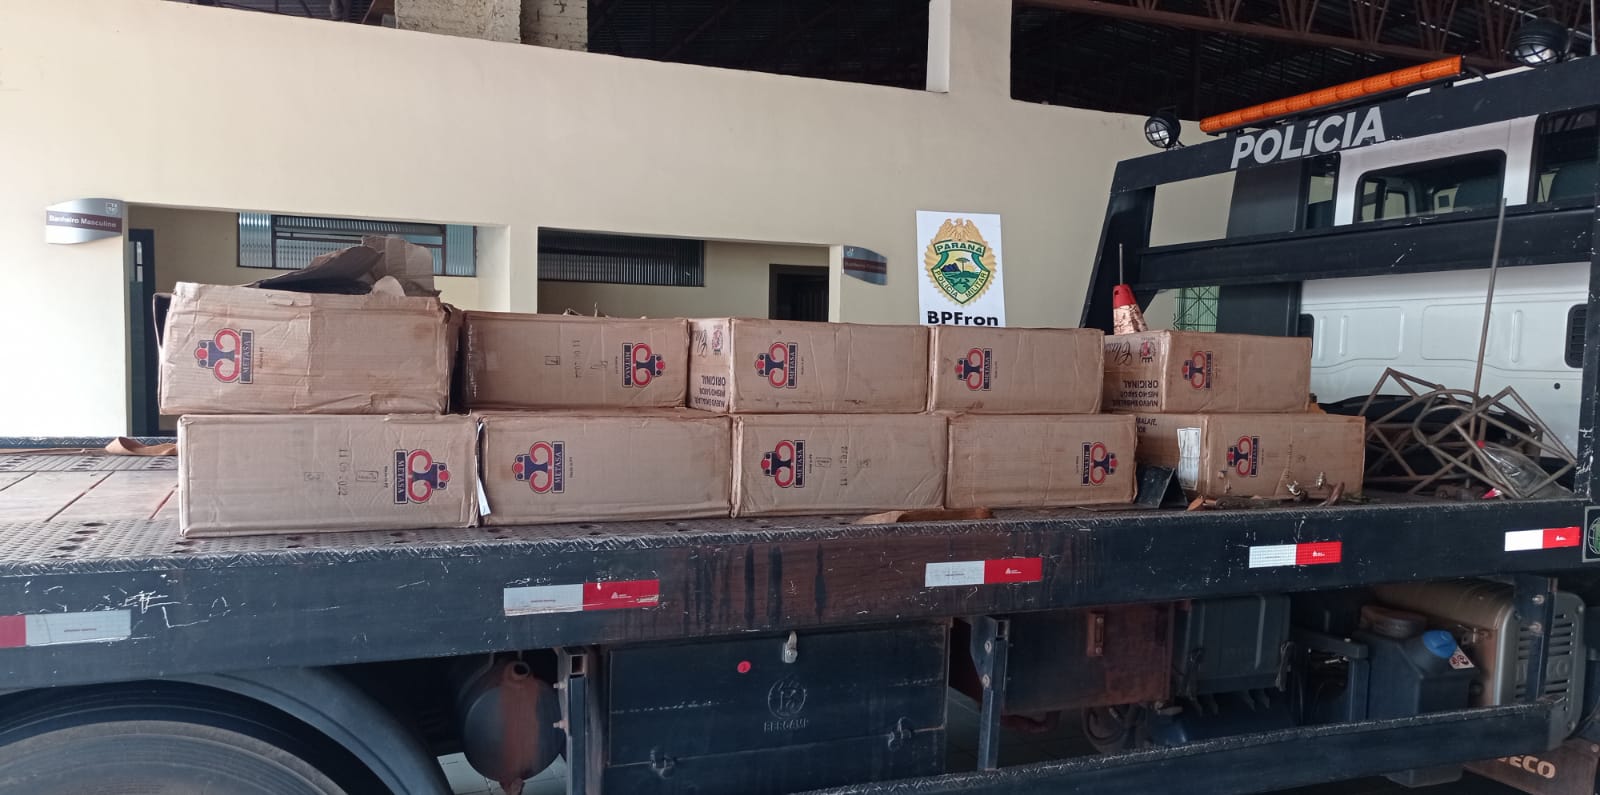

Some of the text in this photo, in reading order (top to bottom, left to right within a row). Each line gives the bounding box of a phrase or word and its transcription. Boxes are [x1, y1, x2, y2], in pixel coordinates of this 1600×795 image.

[81, 218, 117, 228] Masculino
[965, 272, 988, 298] MILITAR
[927, 310, 999, 326] BPFron
[242, 340, 251, 374] METASA
[701, 375, 726, 386] ORIGINAL
[1123, 380, 1159, 389] ORIGINAL
[554, 451, 562, 484] METASA
